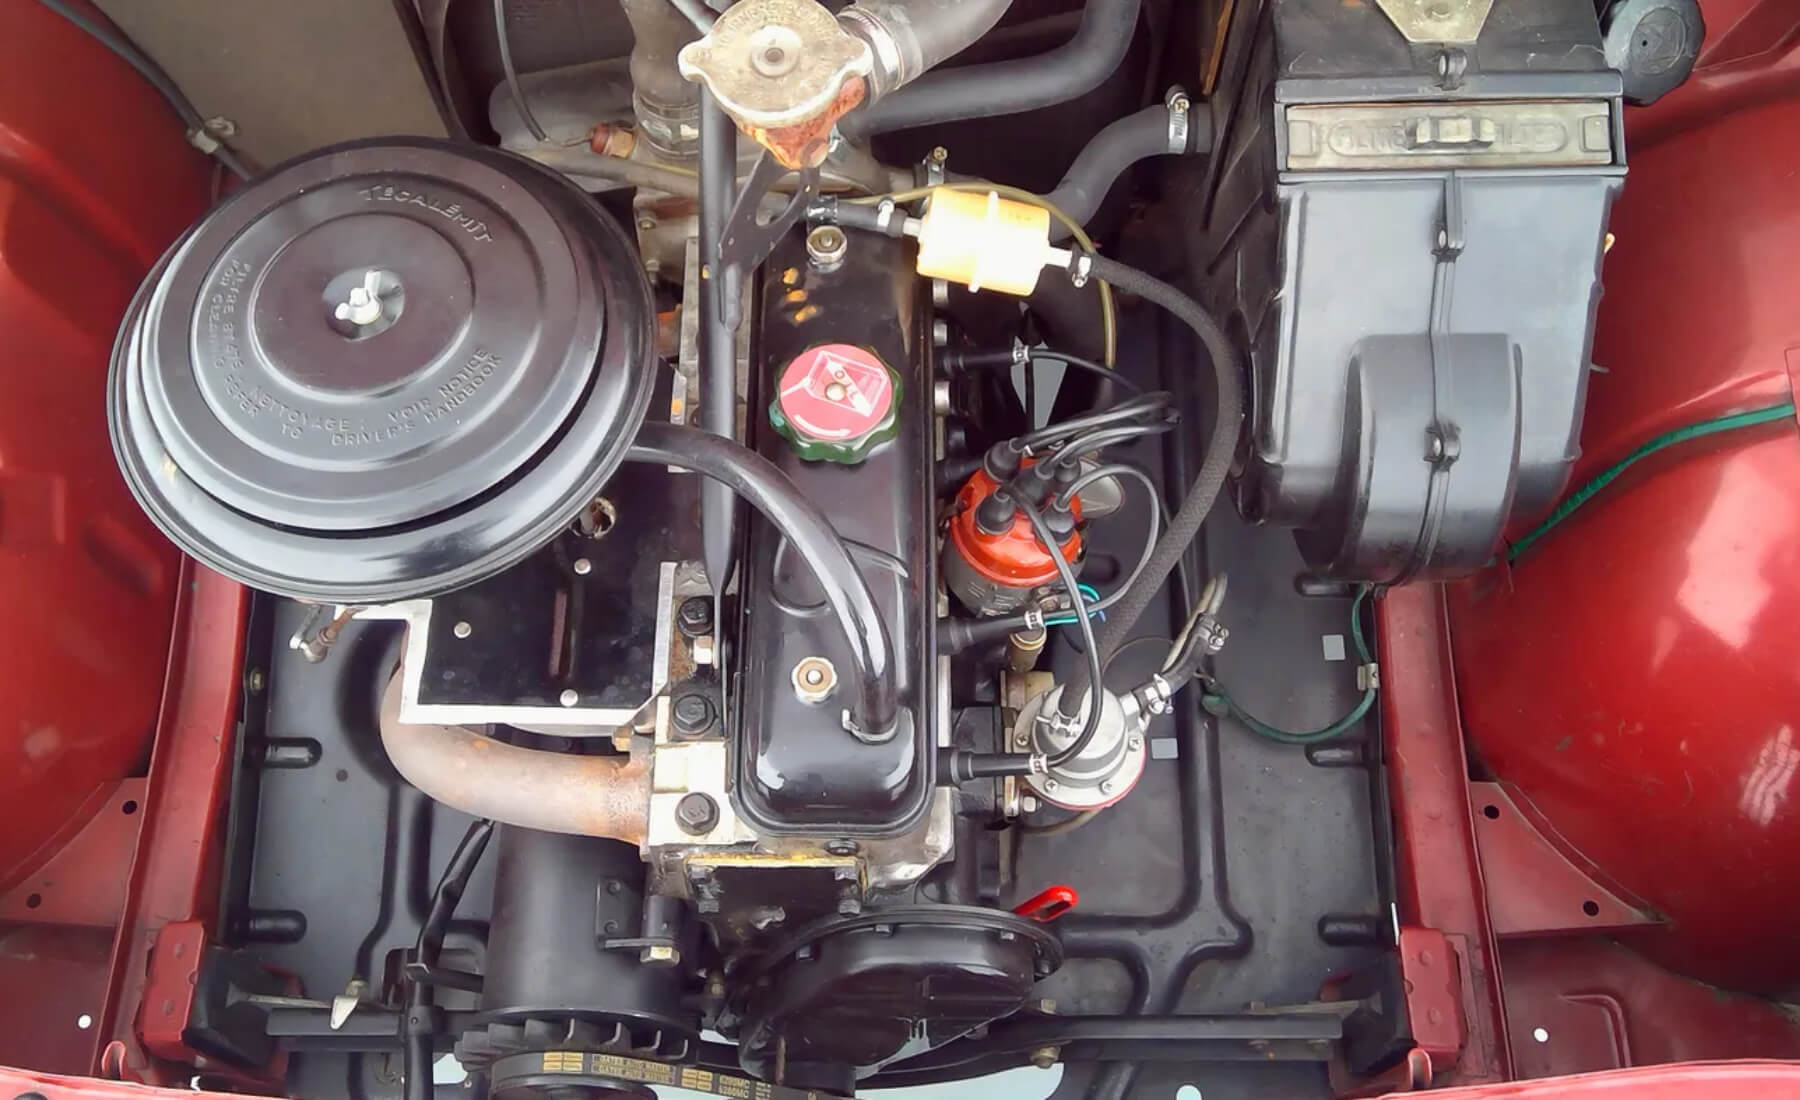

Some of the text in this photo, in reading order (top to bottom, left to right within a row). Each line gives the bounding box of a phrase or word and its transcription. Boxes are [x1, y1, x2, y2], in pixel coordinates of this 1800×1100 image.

[358, 185, 493, 242] TECALEMIT
[281, 423, 304, 440] TO
[423, 353, 502, 425] HANDBOOK
[388, 397, 432, 423] VOIR
[439, 347, 489, 399] NOTICE
